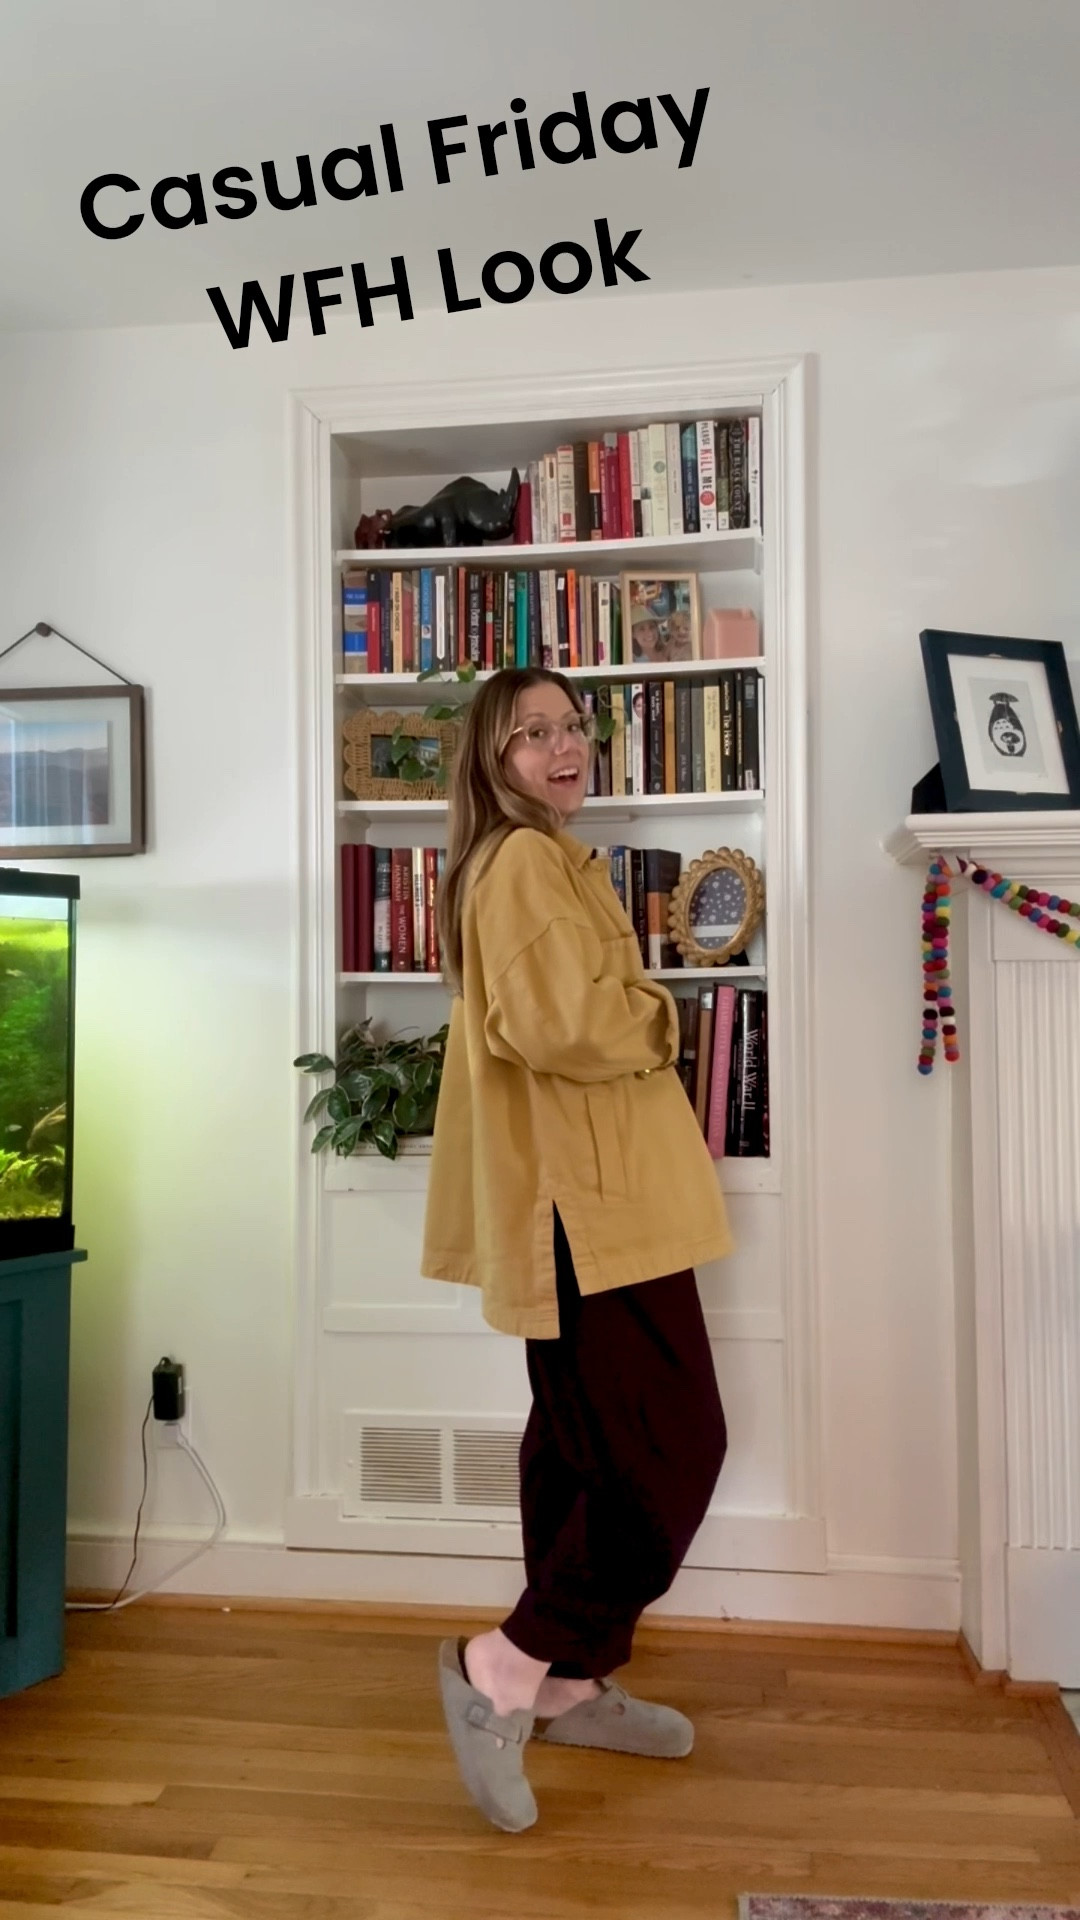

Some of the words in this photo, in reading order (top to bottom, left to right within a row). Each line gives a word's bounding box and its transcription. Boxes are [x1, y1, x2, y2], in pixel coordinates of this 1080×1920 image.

[701, 422, 711, 446] PLEASE
[733, 438, 742, 455] THE
[733, 456, 742, 482] BLACK
[702, 476, 713, 490] ME
[733, 484, 742, 512] COUNT
[723, 713, 733, 730] The
[723, 730, 733, 757] Hollow
[402, 865, 410, 901] KRISTIN
[398, 915, 407, 954] WOMEN
[718, 995, 731, 1051] CHARLOTTE
[743, 1028, 760, 1069] World
[742, 1071, 758, 1099] War
